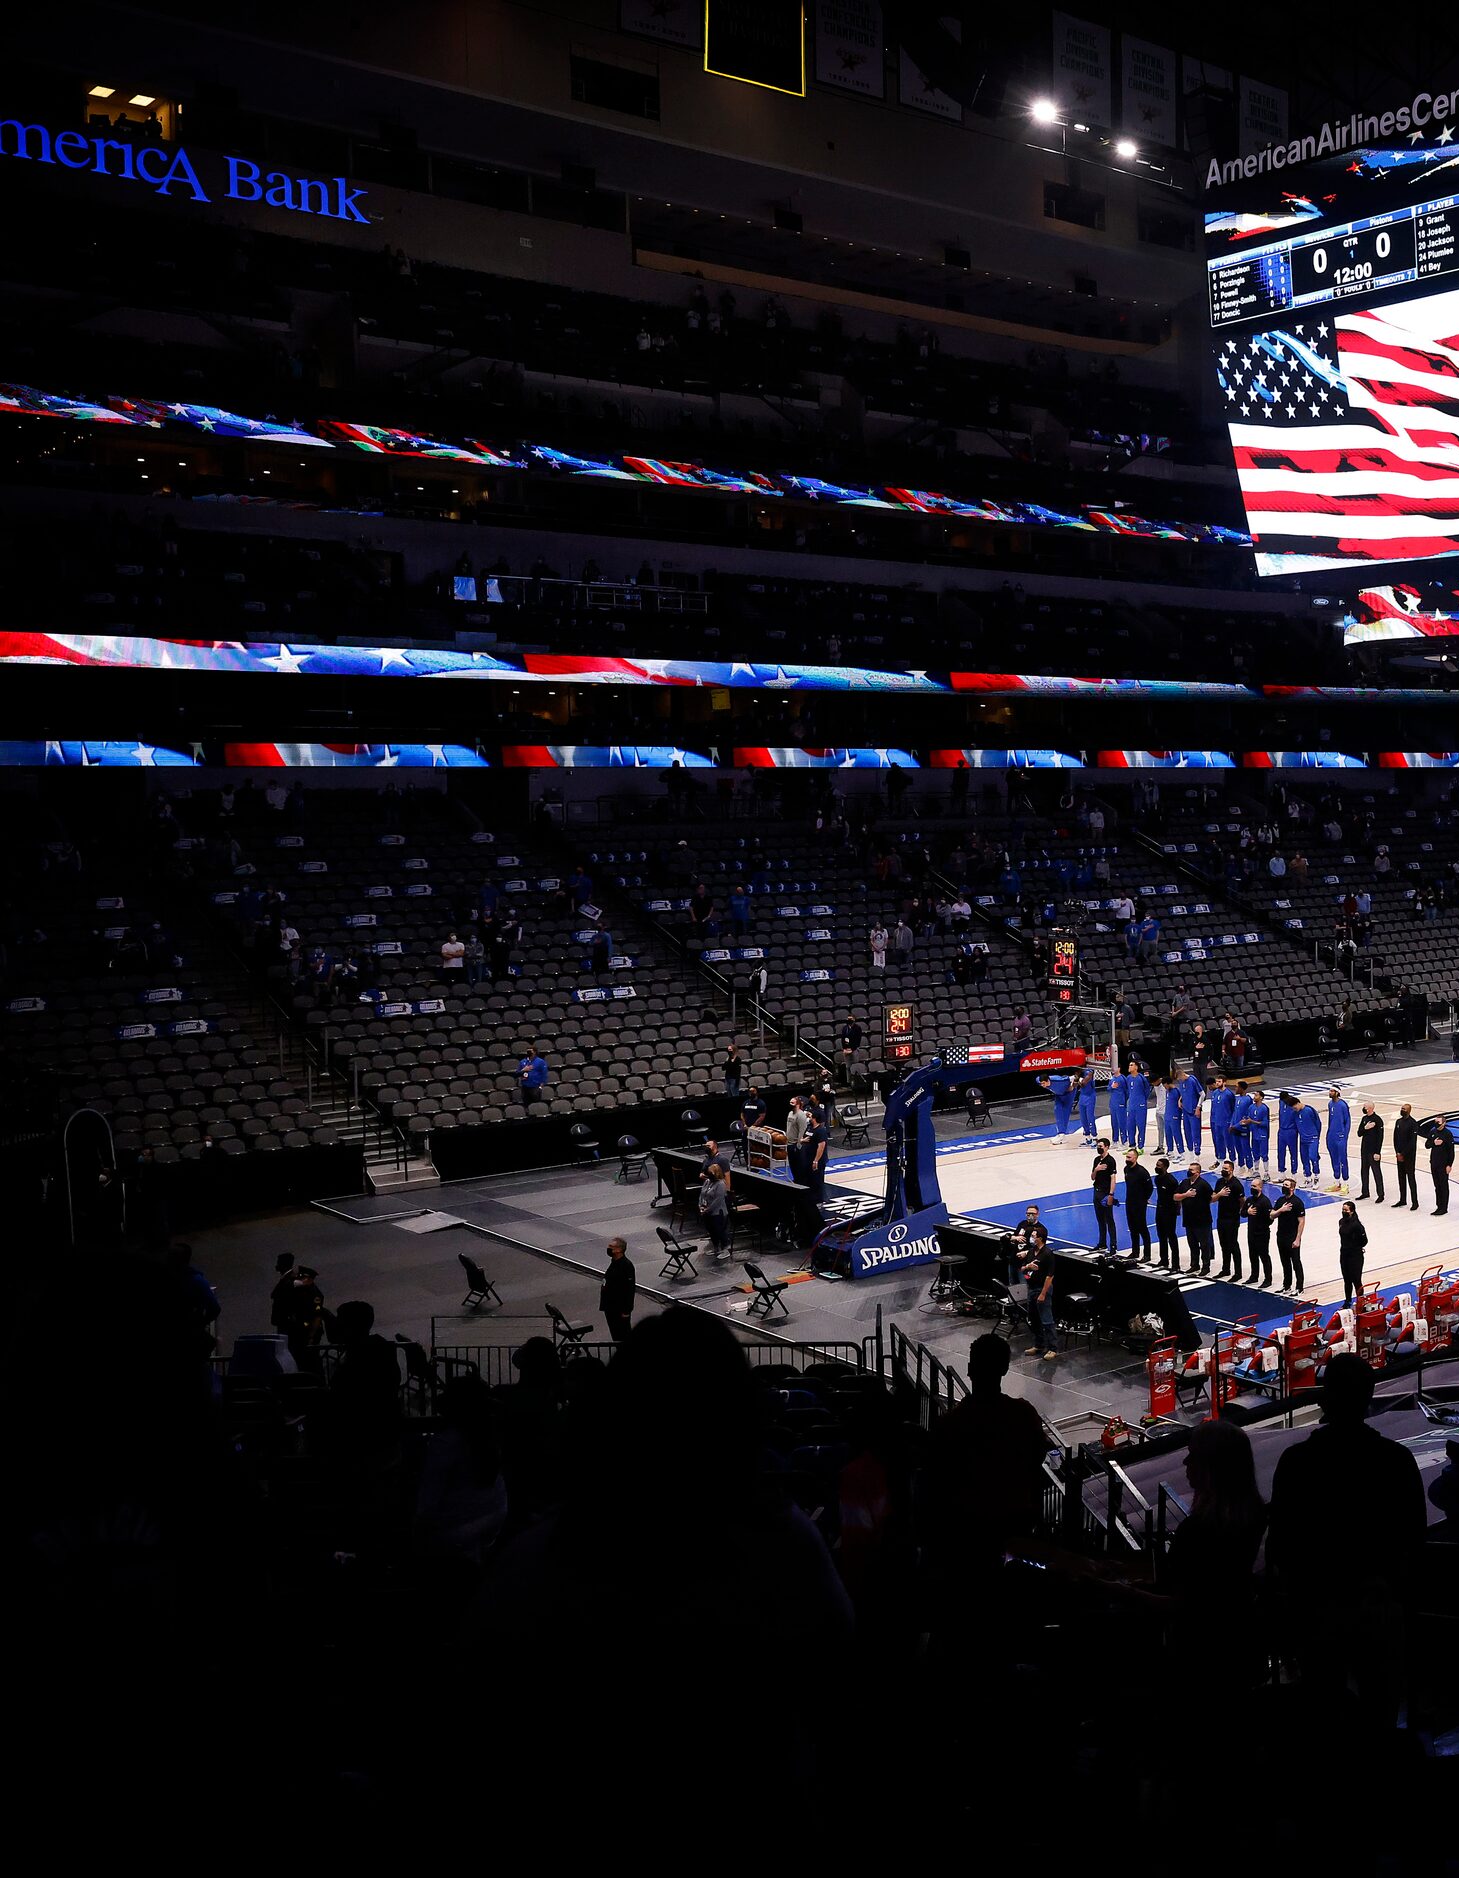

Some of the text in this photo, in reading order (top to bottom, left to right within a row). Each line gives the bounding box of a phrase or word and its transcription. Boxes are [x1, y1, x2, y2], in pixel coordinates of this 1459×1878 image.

[1133, 63, 1165, 85] DIVISION
[223, 155, 371, 224] Bank
[1428, 199, 1454, 211] PLAYER
[1370, 216, 1393, 227] Pistons
[1426, 214, 1445, 224] Grant
[1427, 224, 1451, 237] Joseph
[1343, 237, 1358, 248] QTR
[1376, 232, 1391, 258] 0
[1427, 235, 1455, 248] Jackson
[1313, 248, 1327, 273] 0
[1418, 253, 1426, 261] 24
[1428, 247, 1454, 259] Plumlee
[1212, 272, 1217, 280] 0
[1219, 265, 1250, 279] Richardson
[1334, 262, 1372, 284] 12:00
[1428, 262, 1441, 271] Bey
[1213, 282, 1217, 290] 6
[1220, 276, 1245, 290] Porzingis
[1220, 288, 1238, 300] Powell
[1213, 303, 1220, 311] 10
[1221, 294, 1257, 309] Finney-Smith
[1214, 312, 1220, 321] 77
[1221, 308, 1240, 319] Doncic
[1055, 942, 1074, 954] 12:00
[1054, 954, 1073, 974] 24
[890, 1009, 909, 1019] 12:00
[890, 1019, 905, 1034] 24
[905, 1086, 924, 1107] SPALDING
[860, 1231, 941, 1270] SPALDING
[1430, 1322, 1449, 1337] BIO
[1429, 1334, 1448, 1344] STEEL
[1360, 1345, 1382, 1360] BIO
